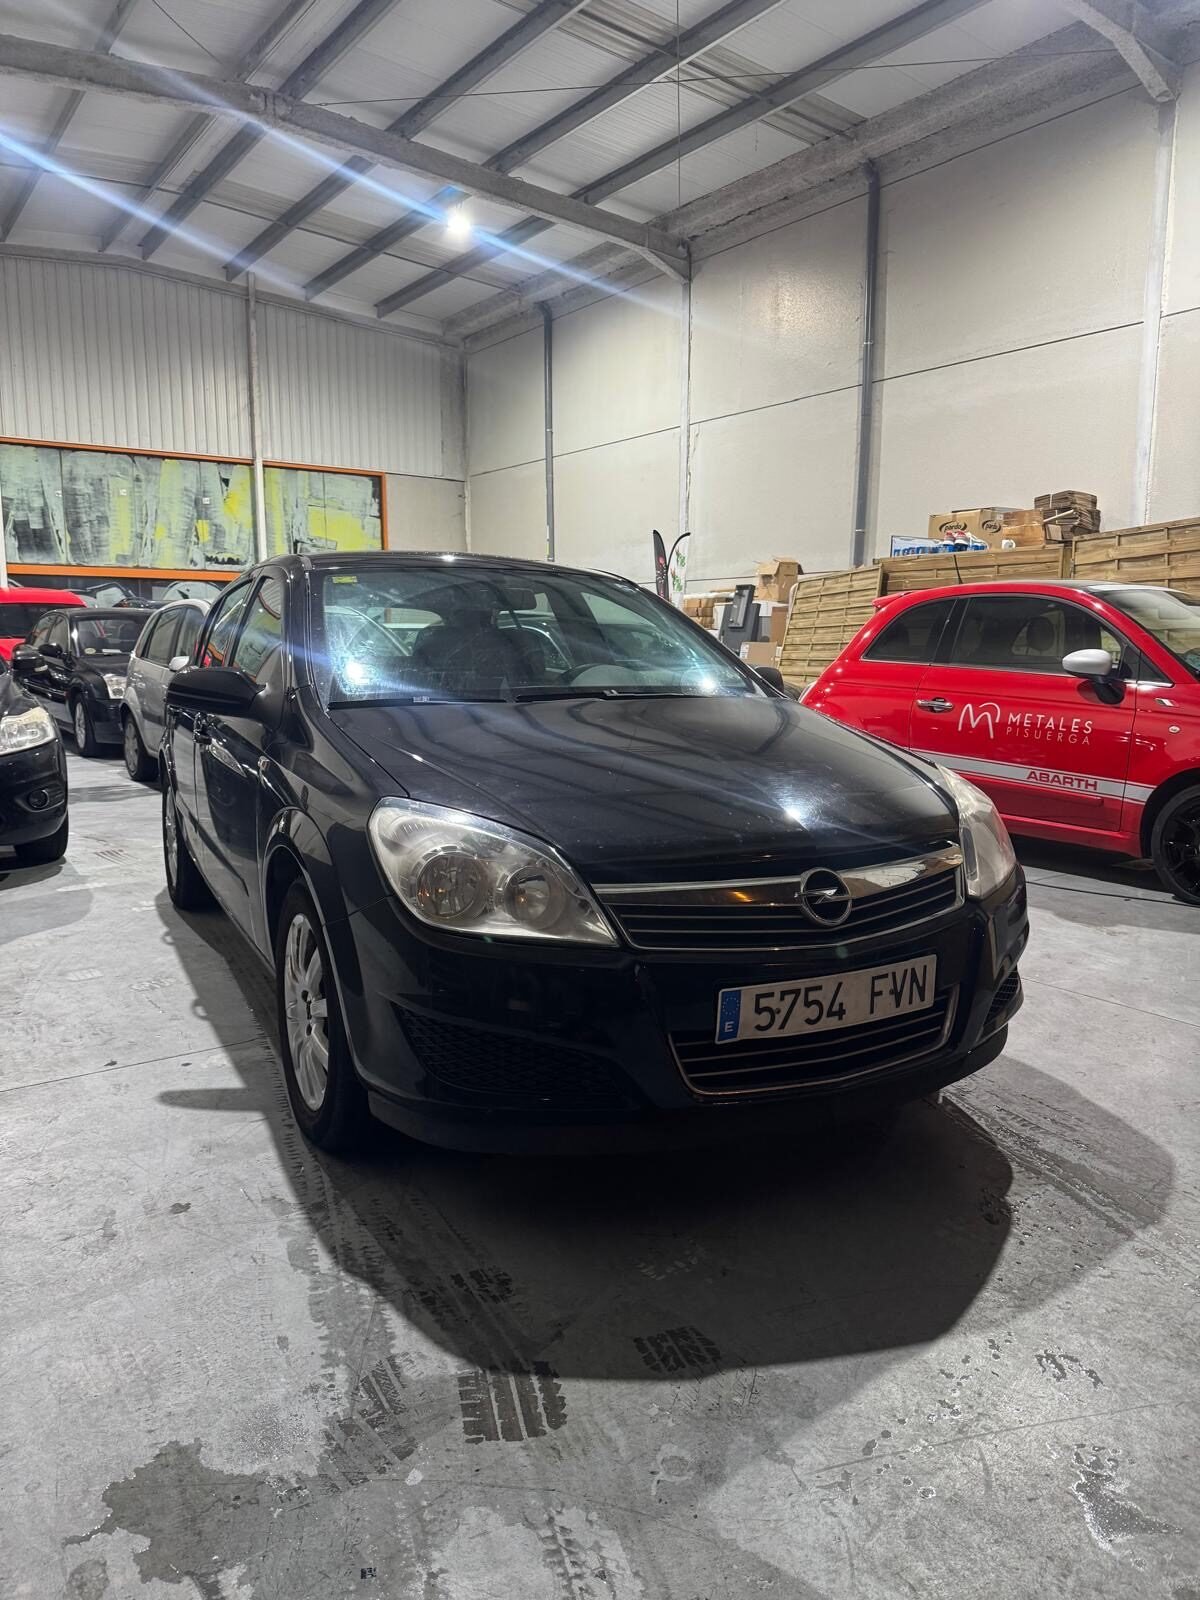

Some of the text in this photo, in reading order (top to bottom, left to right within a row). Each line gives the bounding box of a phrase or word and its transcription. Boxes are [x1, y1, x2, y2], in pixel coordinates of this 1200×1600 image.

[1007, 712, 1093, 734] METALES
[1006, 726, 1090, 745] PISUERGA
[1026, 770, 1098, 791] ABARTH
[754, 964, 927, 1032] 5754 FVN
[724, 1021, 734, 1033] E
